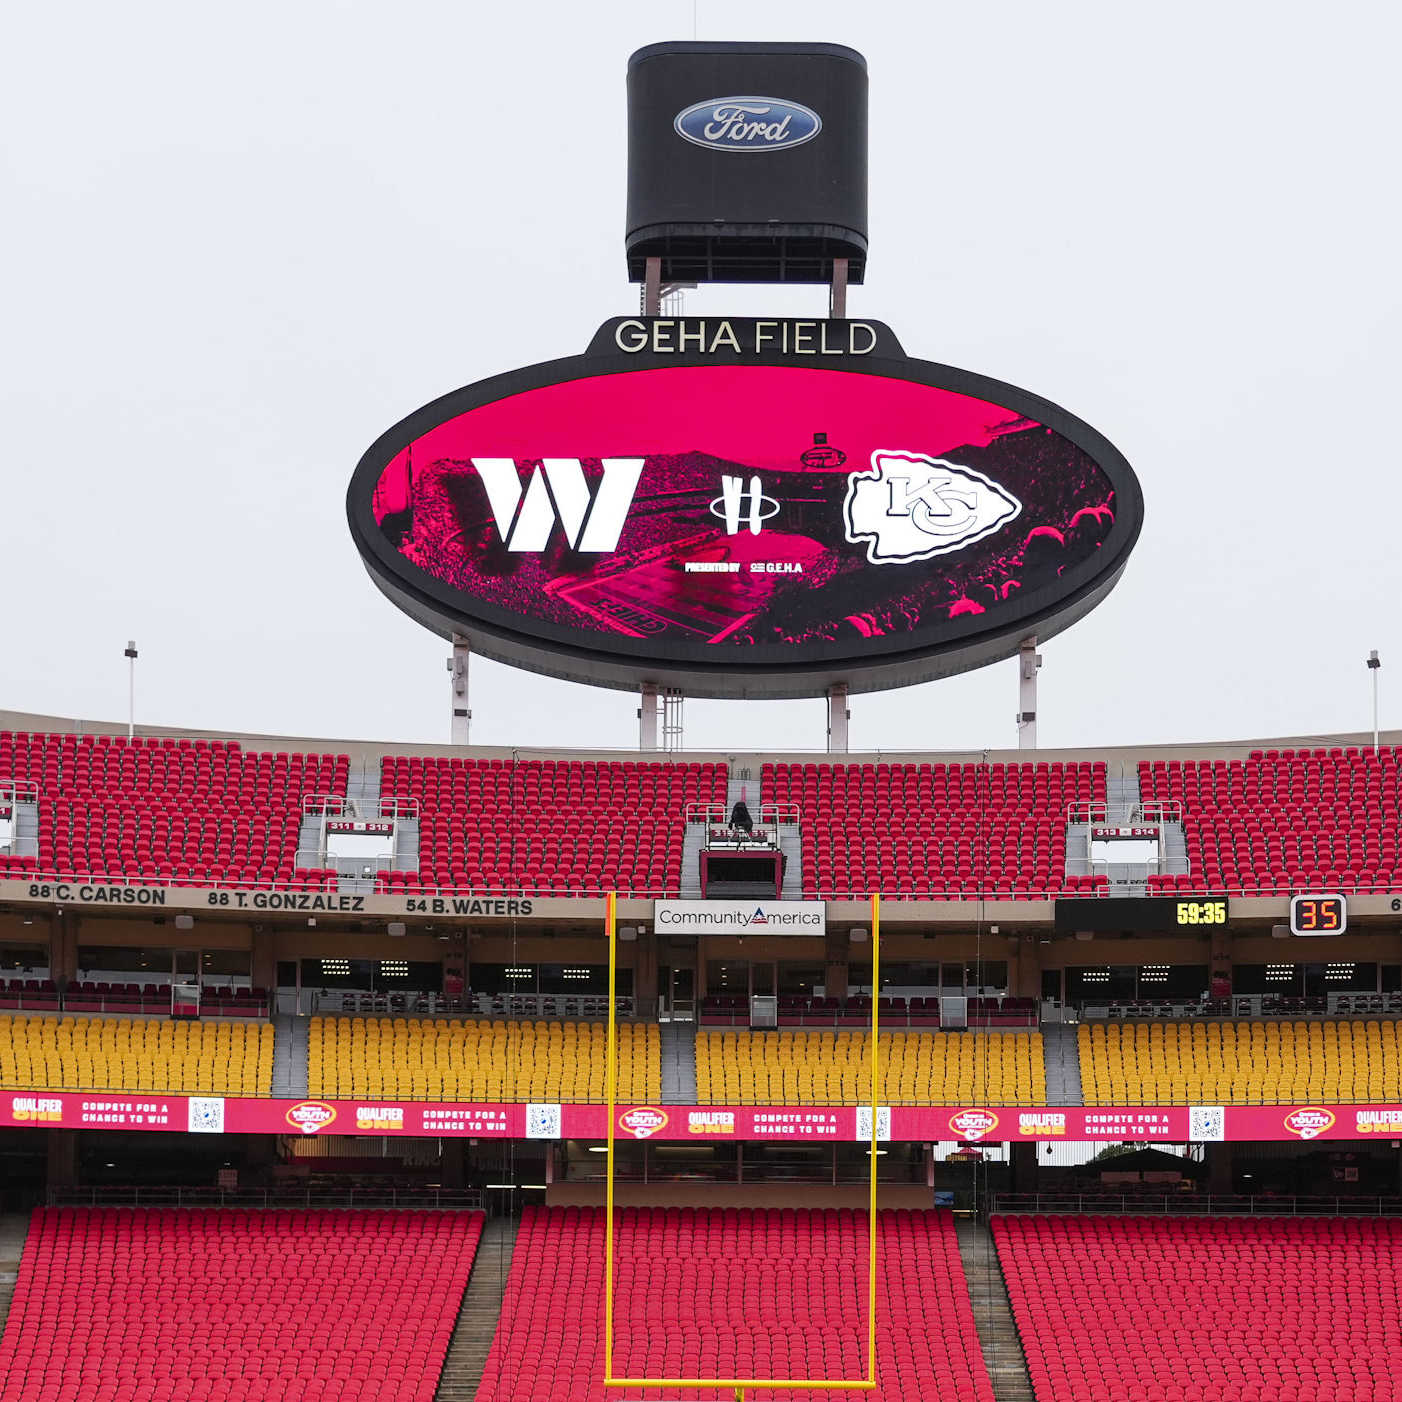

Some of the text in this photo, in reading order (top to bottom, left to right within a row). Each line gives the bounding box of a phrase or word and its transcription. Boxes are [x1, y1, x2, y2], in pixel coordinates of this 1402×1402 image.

[704, 105, 792, 140] Ford
[615, 320, 877, 355] GEHA FIELD
[685, 562, 728, 572] PRESENTED
[330, 822, 390, 832] 311 312
[1097, 828, 1154, 836] 313 314
[29, 885, 165, 904] 88 C. CARSON
[208, 893, 364, 911] 88 T. GONZALEZ
[406, 899, 532, 915] 54 B. WATERS
[1177, 903, 1226, 924] 59:35
[1302, 901, 1337, 929] 35
[13, 1098, 62, 1112] QUALIFIER
[81, 1101, 169, 1113] COMPETE FOR A
[13, 1111, 62, 1121] ONE
[81, 1112, 168, 1124] CHANCE TO WIN
[956, 1118, 992, 1126] YOUTH
[1019, 1113, 1065, 1126] QUALIFIER
[1085, 1114, 1169, 1124] COMPETE FOR A
[1019, 1126, 1065, 1136] ONE
[1084, 1125, 1169, 1135] CHANCE TO WIN
